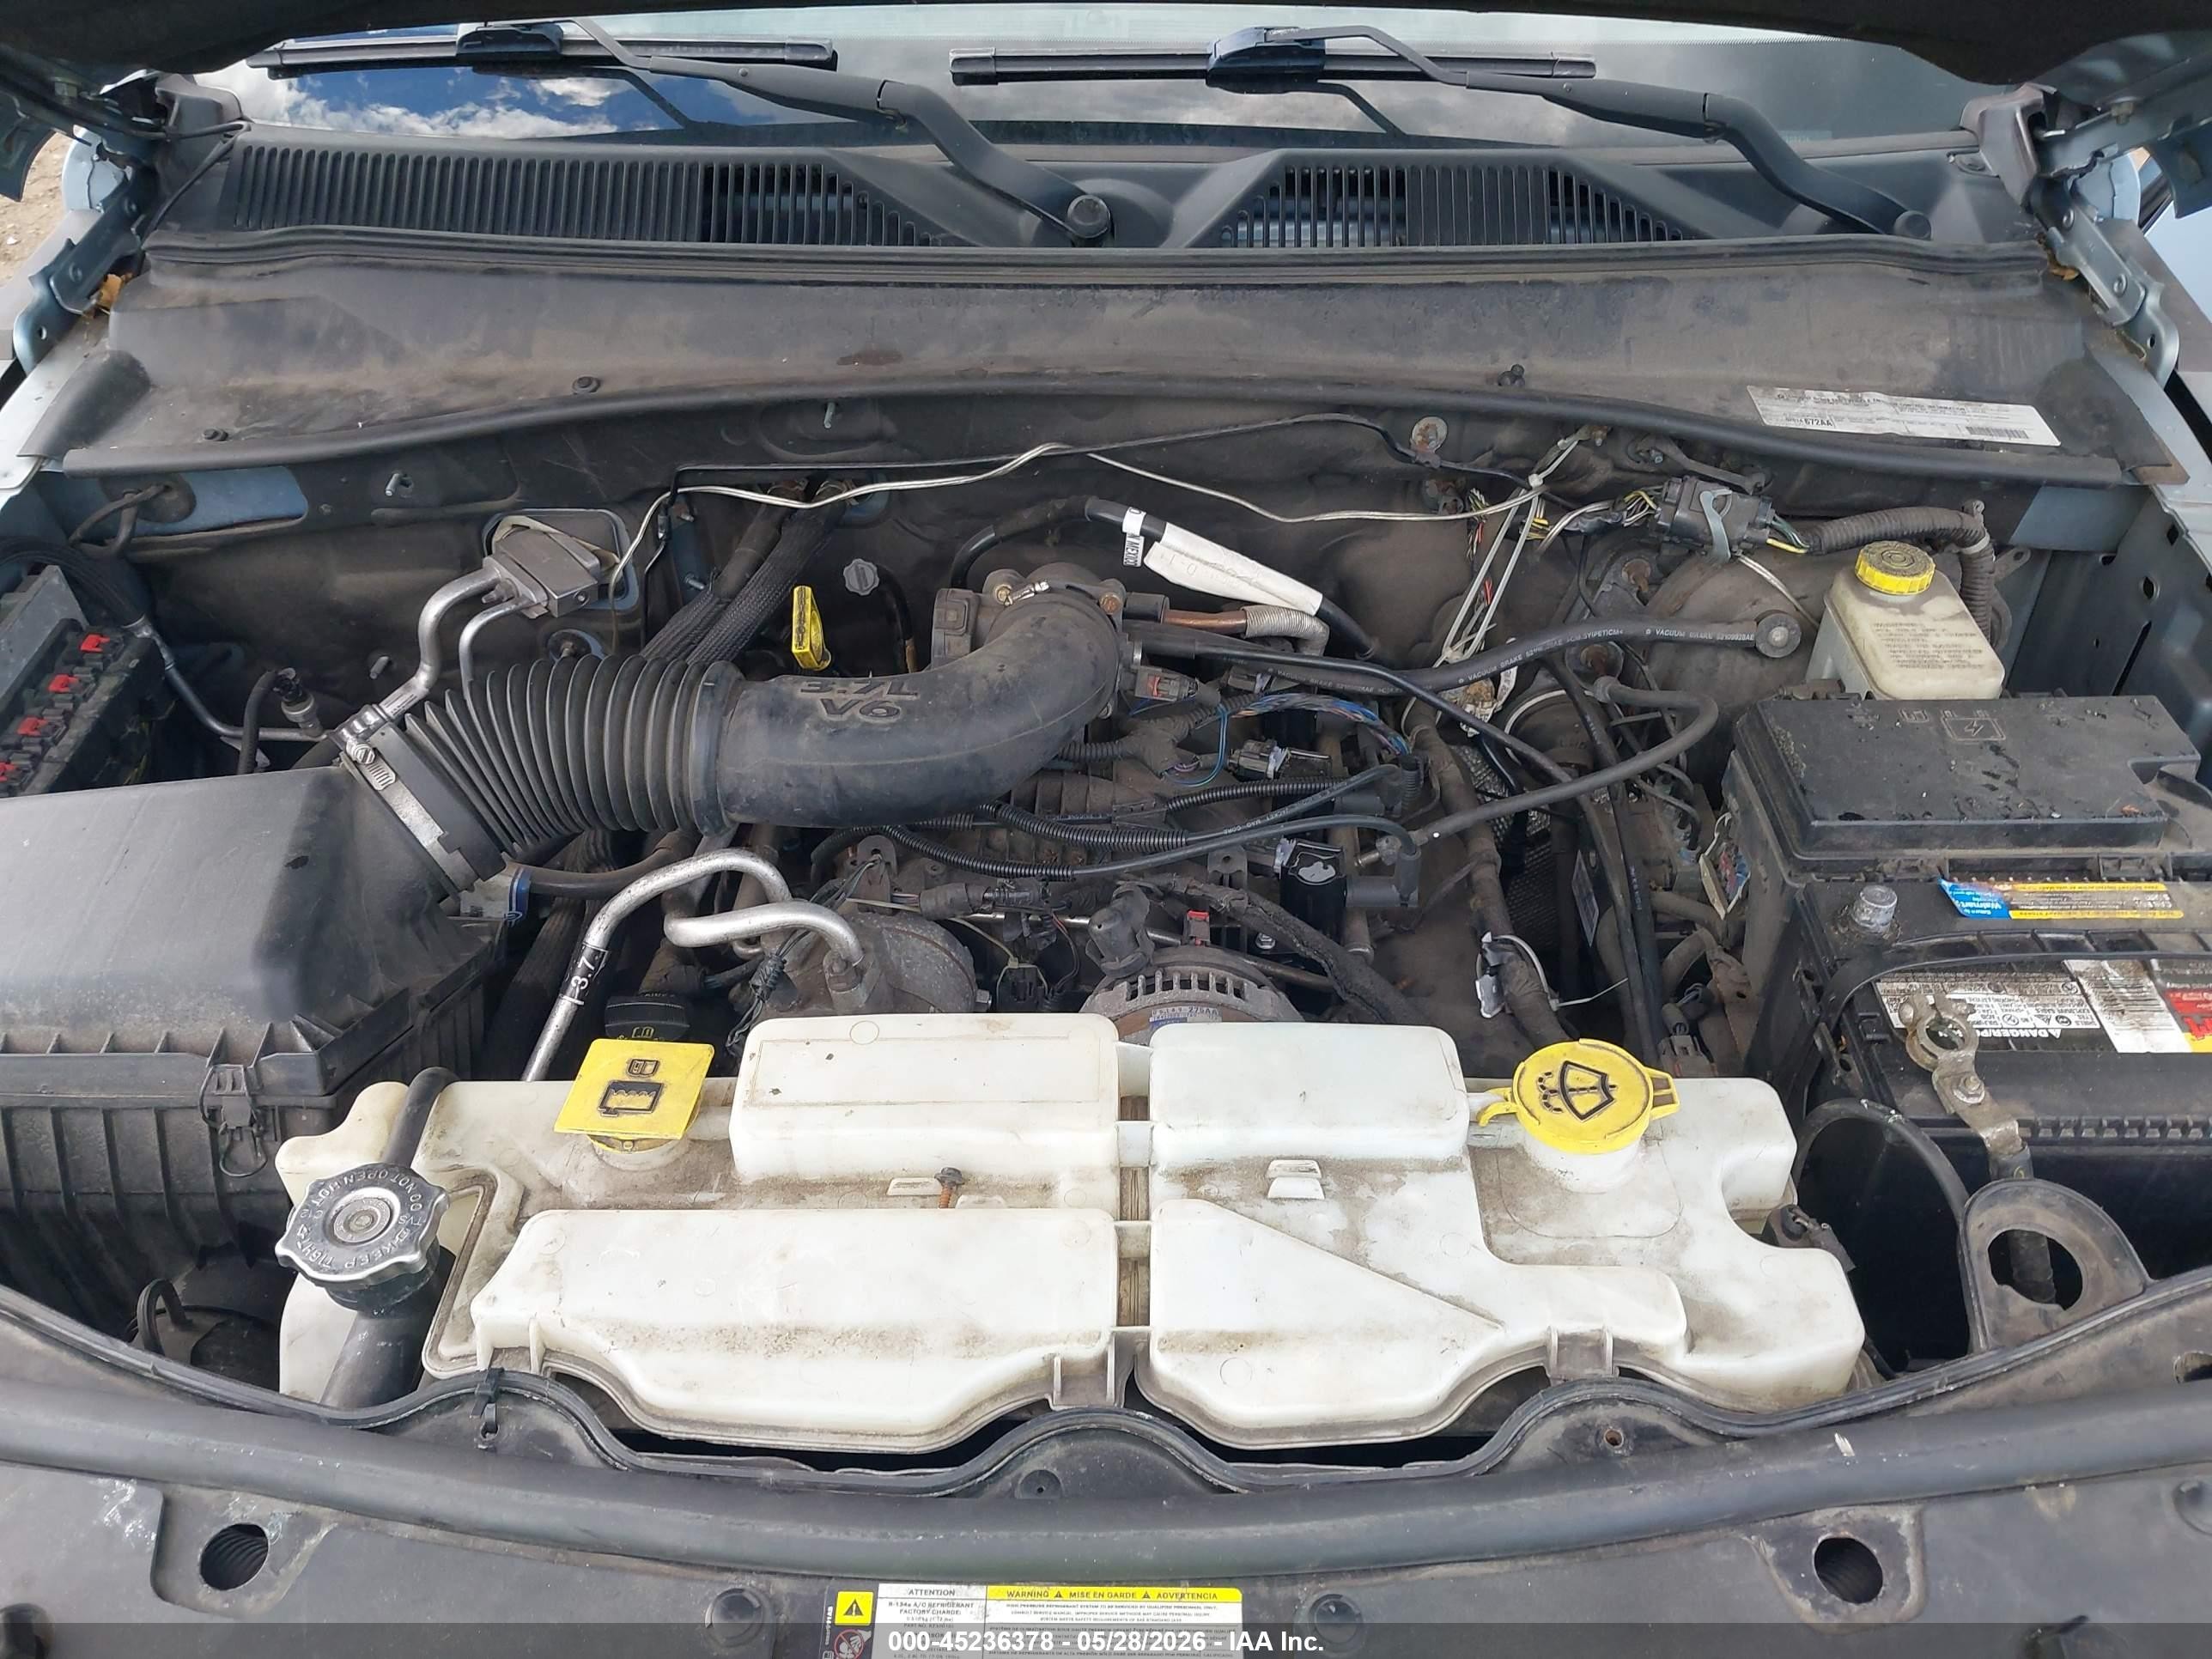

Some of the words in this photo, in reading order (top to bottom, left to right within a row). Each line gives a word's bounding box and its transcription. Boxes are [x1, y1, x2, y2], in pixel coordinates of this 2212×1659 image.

[819, 697, 902, 720] V6
[1959, 901, 2002, 910] Walmart
[343, 1169, 389, 1185] OPEN
[390, 1173, 416, 1194] NOT
[310, 1182, 341, 1206] HOT
[409, 1193, 423, 1212] DO
[398, 1214, 422, 1226] TVS
[295, 1238, 335, 1269] TIGHT
[343, 1243, 397, 1269] KEEP
[1006, 1590, 1049, 1599] WARNING
[1069, 1591, 1091, 1600] MISE
[1093, 1591, 1105, 1600] EN
[1107, 1591, 1137, 1600] GARDE
[1156, 1592, 1218, 1601] ADVERTENCIA
